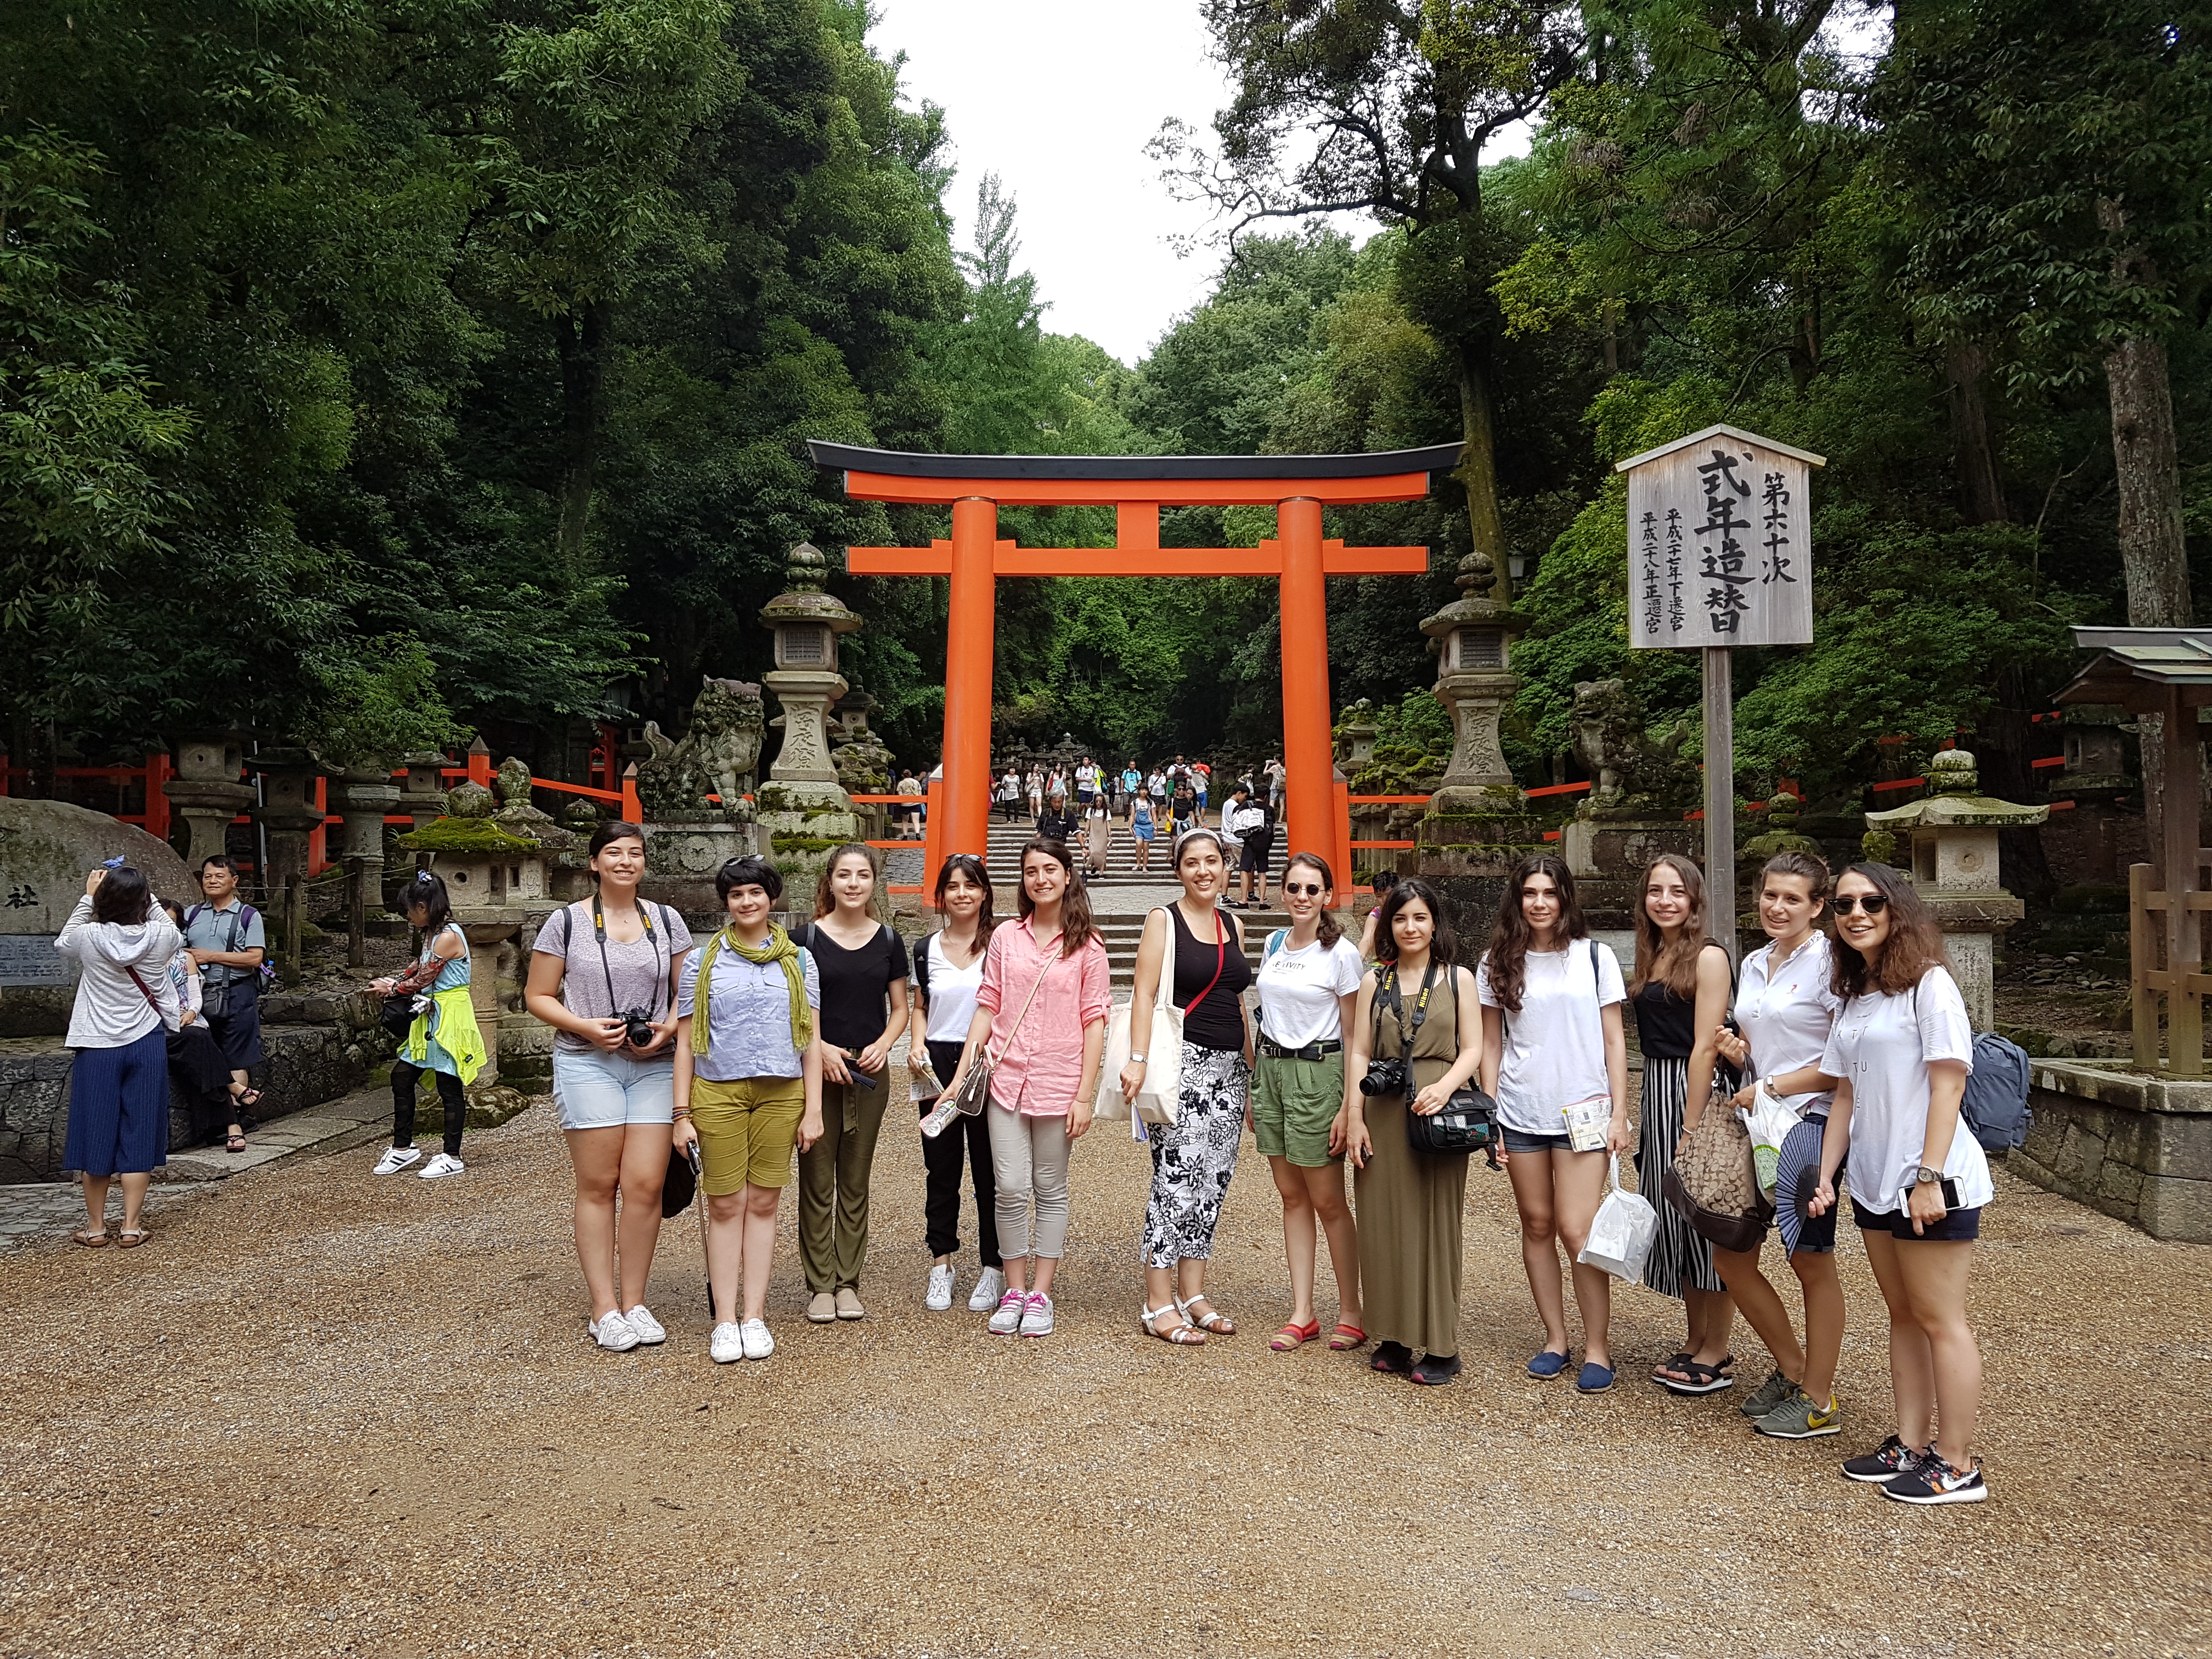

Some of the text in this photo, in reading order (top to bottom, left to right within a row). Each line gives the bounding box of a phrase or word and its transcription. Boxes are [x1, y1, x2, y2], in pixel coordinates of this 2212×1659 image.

[1640, 511, 1663, 634] 平成二十八年正遷宮
[1664, 508, 1686, 633] 平成二十七年下遷宮
[1694, 450, 1757, 633] 式年造替
[1762, 472, 1798, 585] 第六十次
[5, 885, 38, 909] 社
[1384, 971, 1394, 990] Nikon
[1418, 988, 1429, 1008] Nikon
